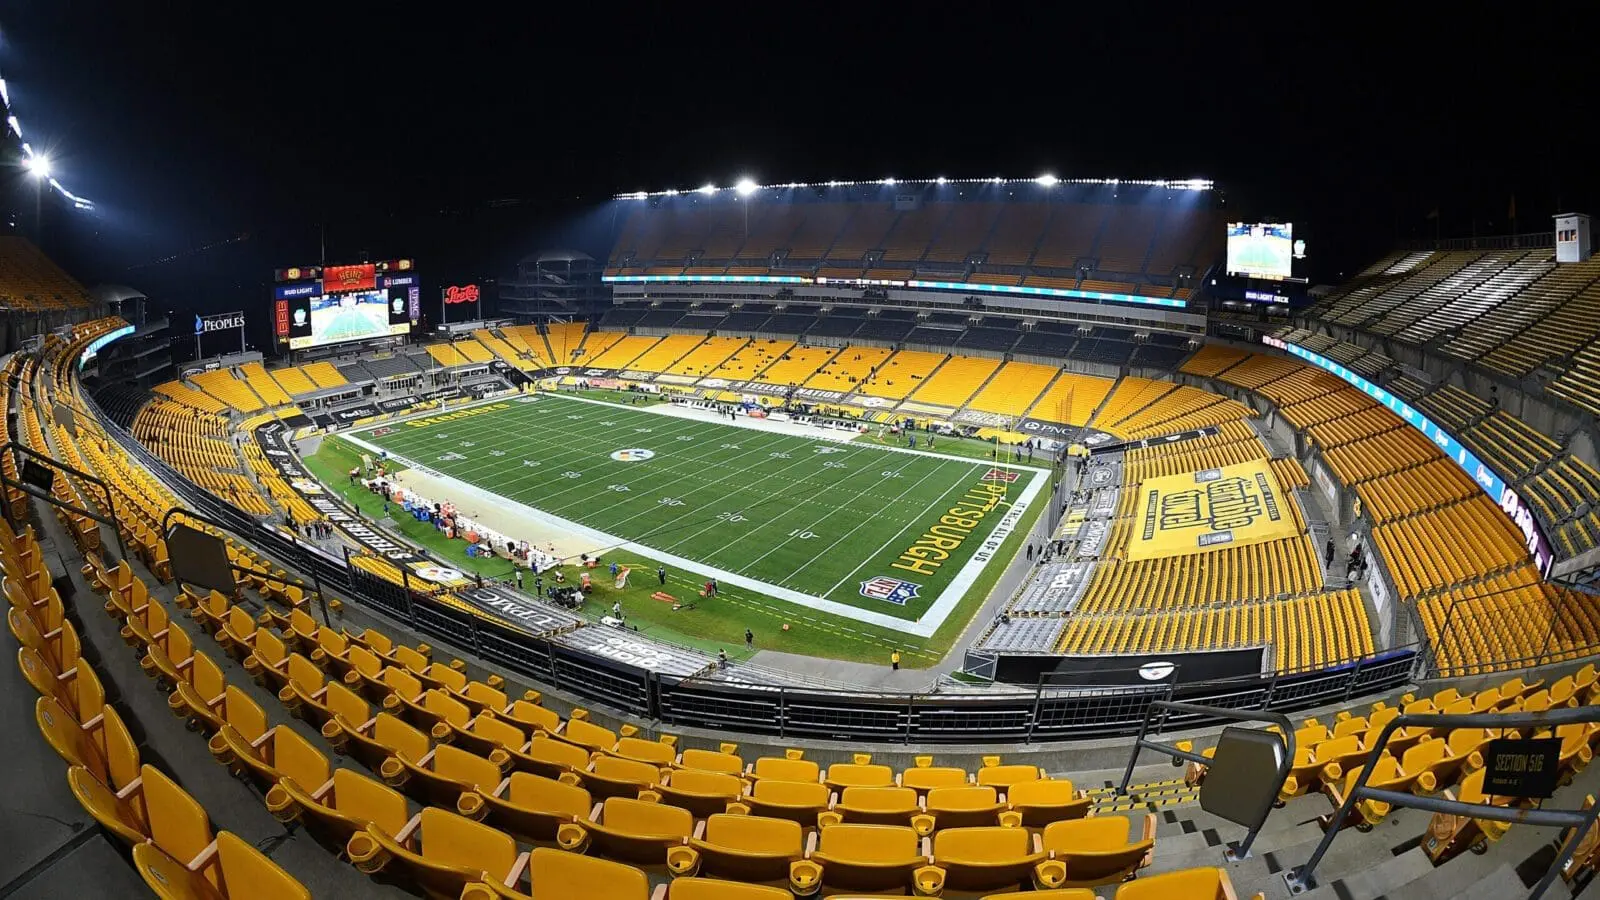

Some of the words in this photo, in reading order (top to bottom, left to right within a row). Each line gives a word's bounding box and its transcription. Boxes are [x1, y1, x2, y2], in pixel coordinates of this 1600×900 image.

[296, 287, 313, 295] LIGHT
[204, 316, 245, 332] PEOPLES
[799, 387, 841, 399] NATION
[405, 402, 510, 427] Steelers
[1040, 424, 1073, 436] PNC
[891, 482, 1008, 576] PITTSBURGH
[974, 552, 991, 562] US
[866, 578, 901, 597] NFL
[474, 591, 553, 626] UPMC
[1495, 754, 1528, 772] SECTION
[1529, 754, 1545, 773] 516
